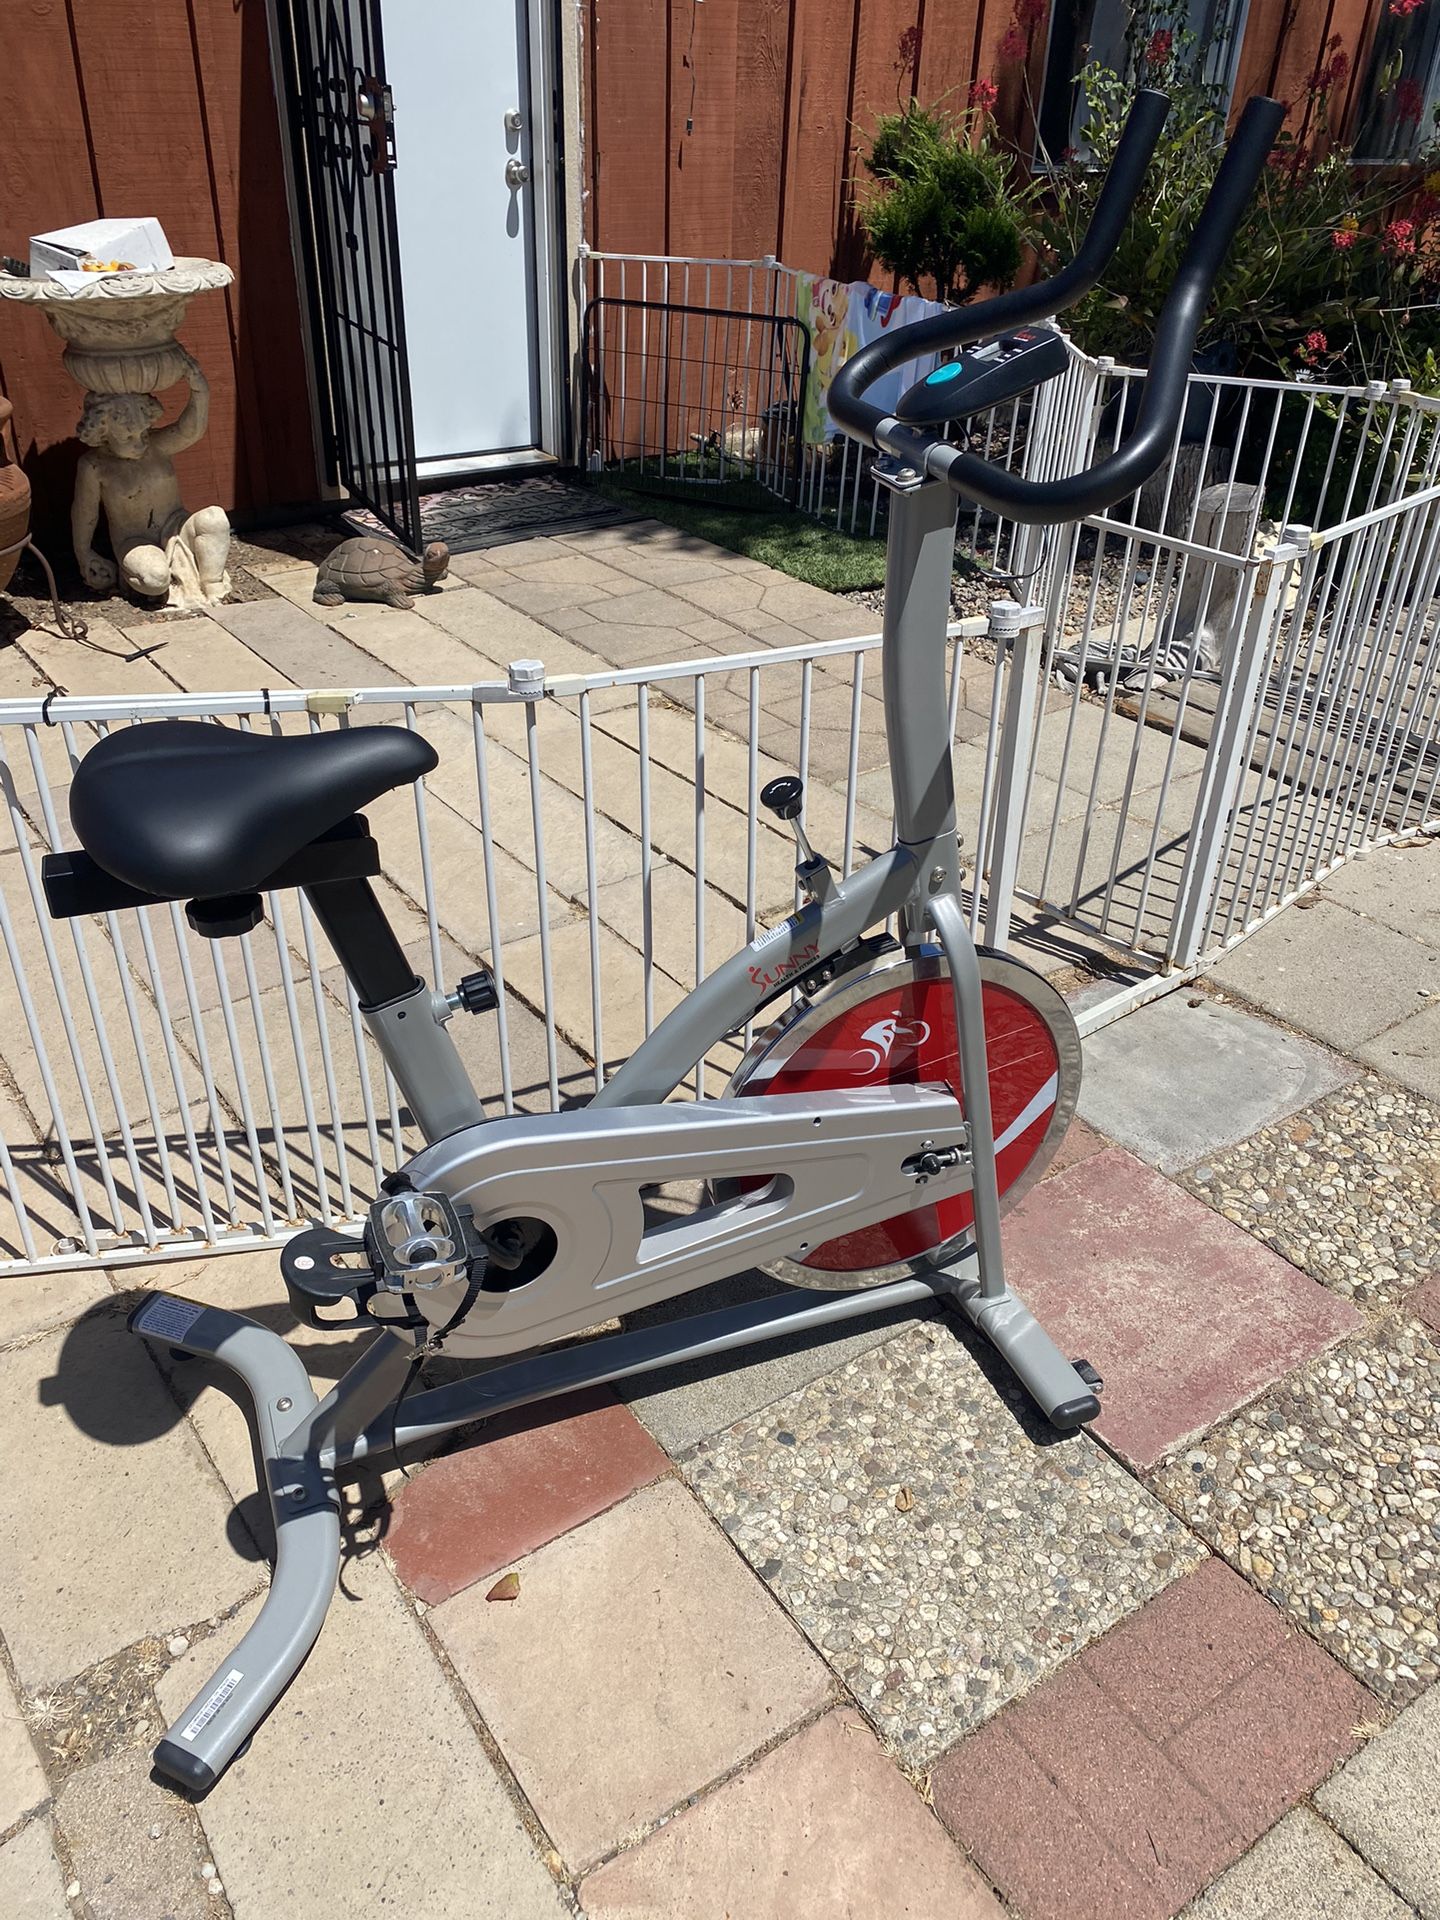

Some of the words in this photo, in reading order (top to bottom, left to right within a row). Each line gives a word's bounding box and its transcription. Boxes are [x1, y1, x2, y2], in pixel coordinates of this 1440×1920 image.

[748, 940, 820, 996] SUNNY
[773, 971, 793, 987] HEALTH
[798, 954, 820, 971] FITNESS
